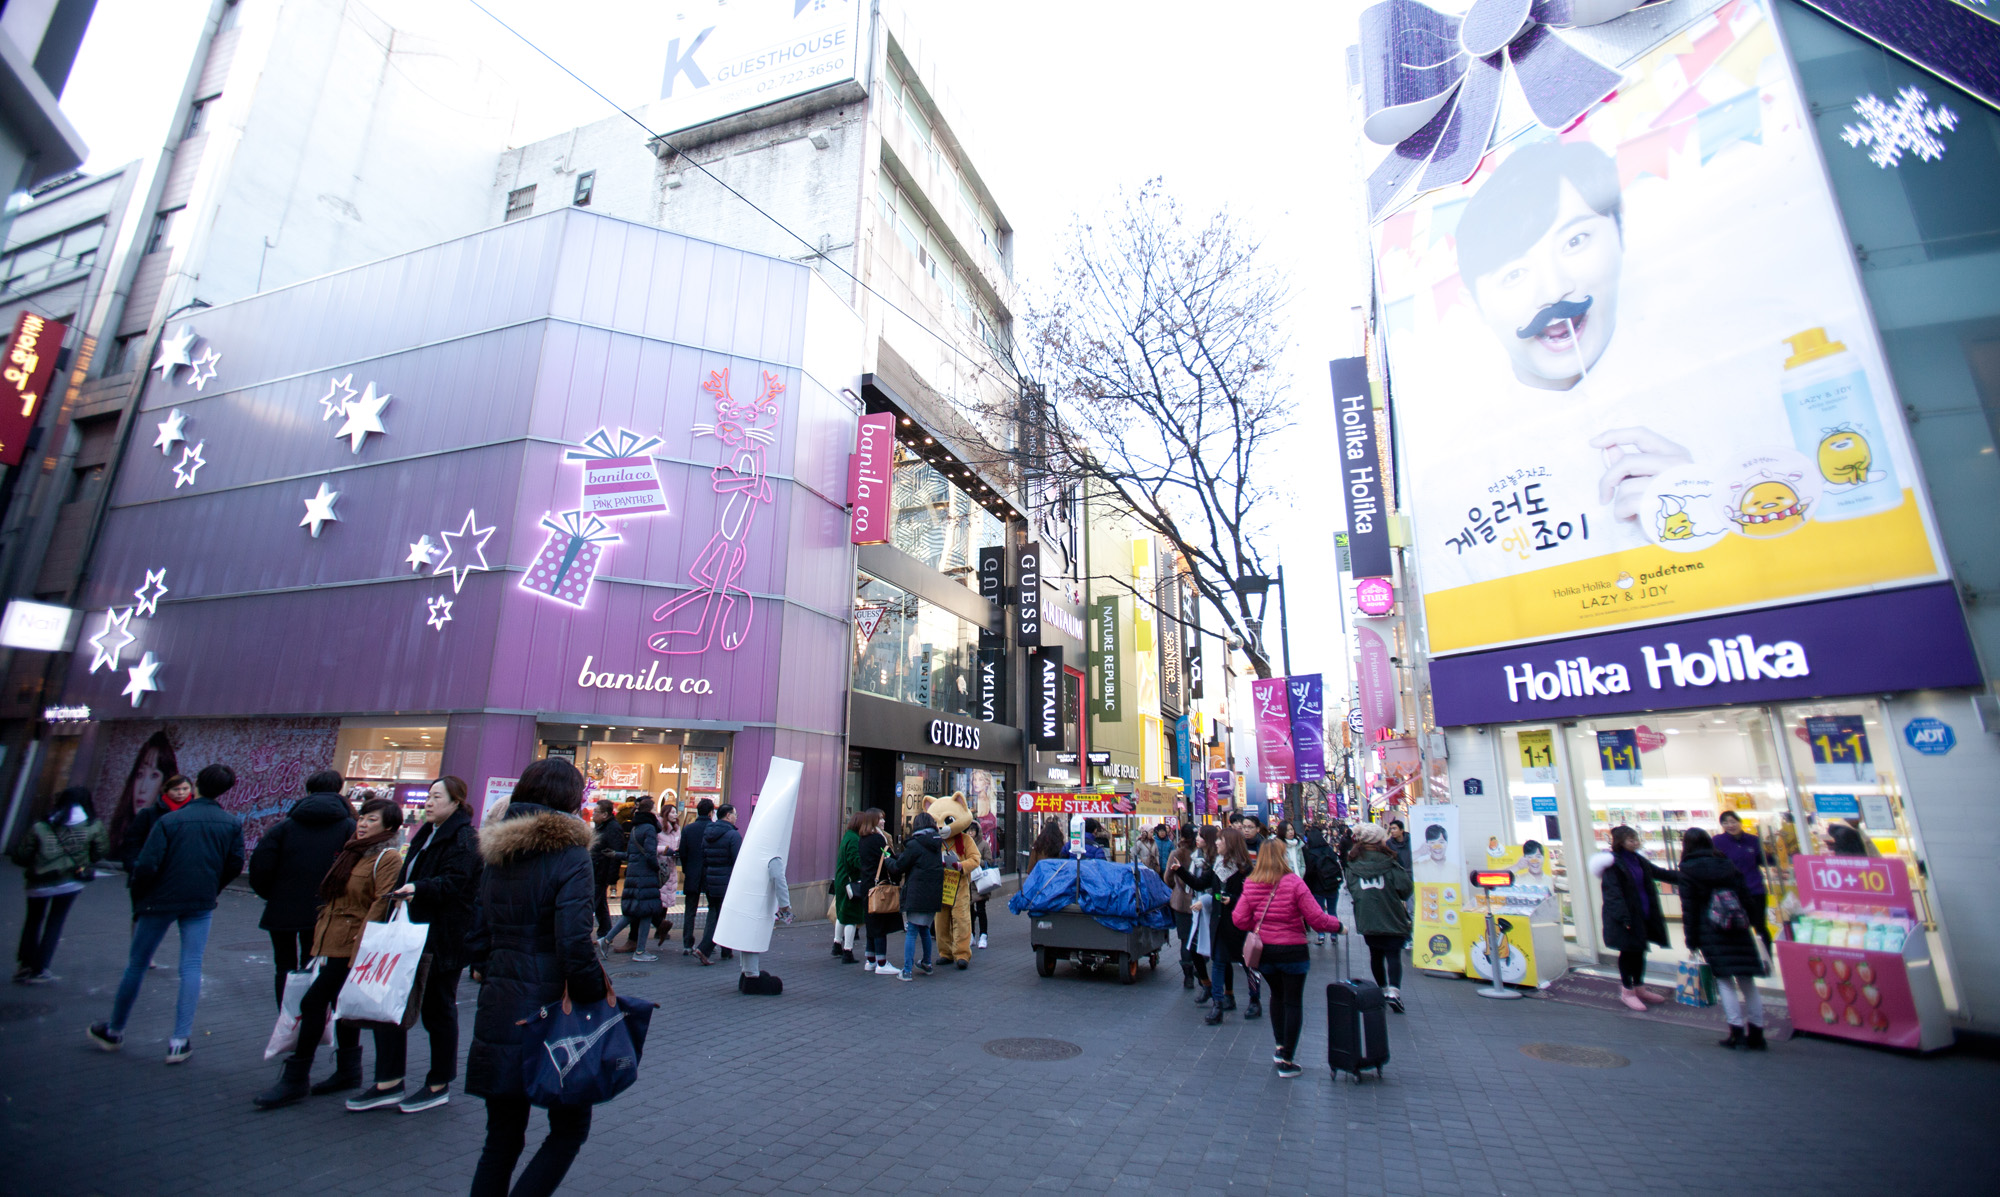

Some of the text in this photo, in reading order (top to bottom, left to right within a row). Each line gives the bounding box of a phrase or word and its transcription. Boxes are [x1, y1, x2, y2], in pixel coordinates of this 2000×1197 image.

[757, 58, 844, 94] 02.722.3650
[588, 468, 653, 483] banila co.
[1341, 395, 1377, 534] Holika Holika
[855, 423, 886, 535] banila co.
[614, 494, 654, 507] PANTHER
[1446, 483, 1549, 555] 게을러도
[1501, 513, 1589, 560] 엔조이
[1639, 562, 1704, 584] gudetama
[1021, 554, 1036, 634] GUESS
[1361, 593, 1389, 602] ETUDE
[1553, 581, 1611, 598] Holika Holika
[1582, 585, 1668, 609] LAZY & JOY
[856, 609, 880, 618] GUESS
[1042, 599, 1083, 641] ARITAUM
[1103, 606, 1115, 711] NATURE REPUBLIC
[1504, 634, 1809, 702] Holika Holika
[578, 656, 713, 694] banila co.
[1042, 659, 1055, 737] ARITAUM
[1375, 690, 1384, 717] House
[931, 719, 980, 750] GUESS
[1914, 728, 1945, 743] ADT
[1524, 745, 1552, 768] 1+1
[1602, 745, 1636, 770] 1+1
[1815, 734, 1864, 763] 1+1
[1120, 765, 1139, 779] REPUBLIC
[1035, 795, 1063, 811] 牛村
[1469, 786, 1478, 794] 37
[1064, 801, 1111, 813] STEAK
[351, 952, 402, 986] H&M
